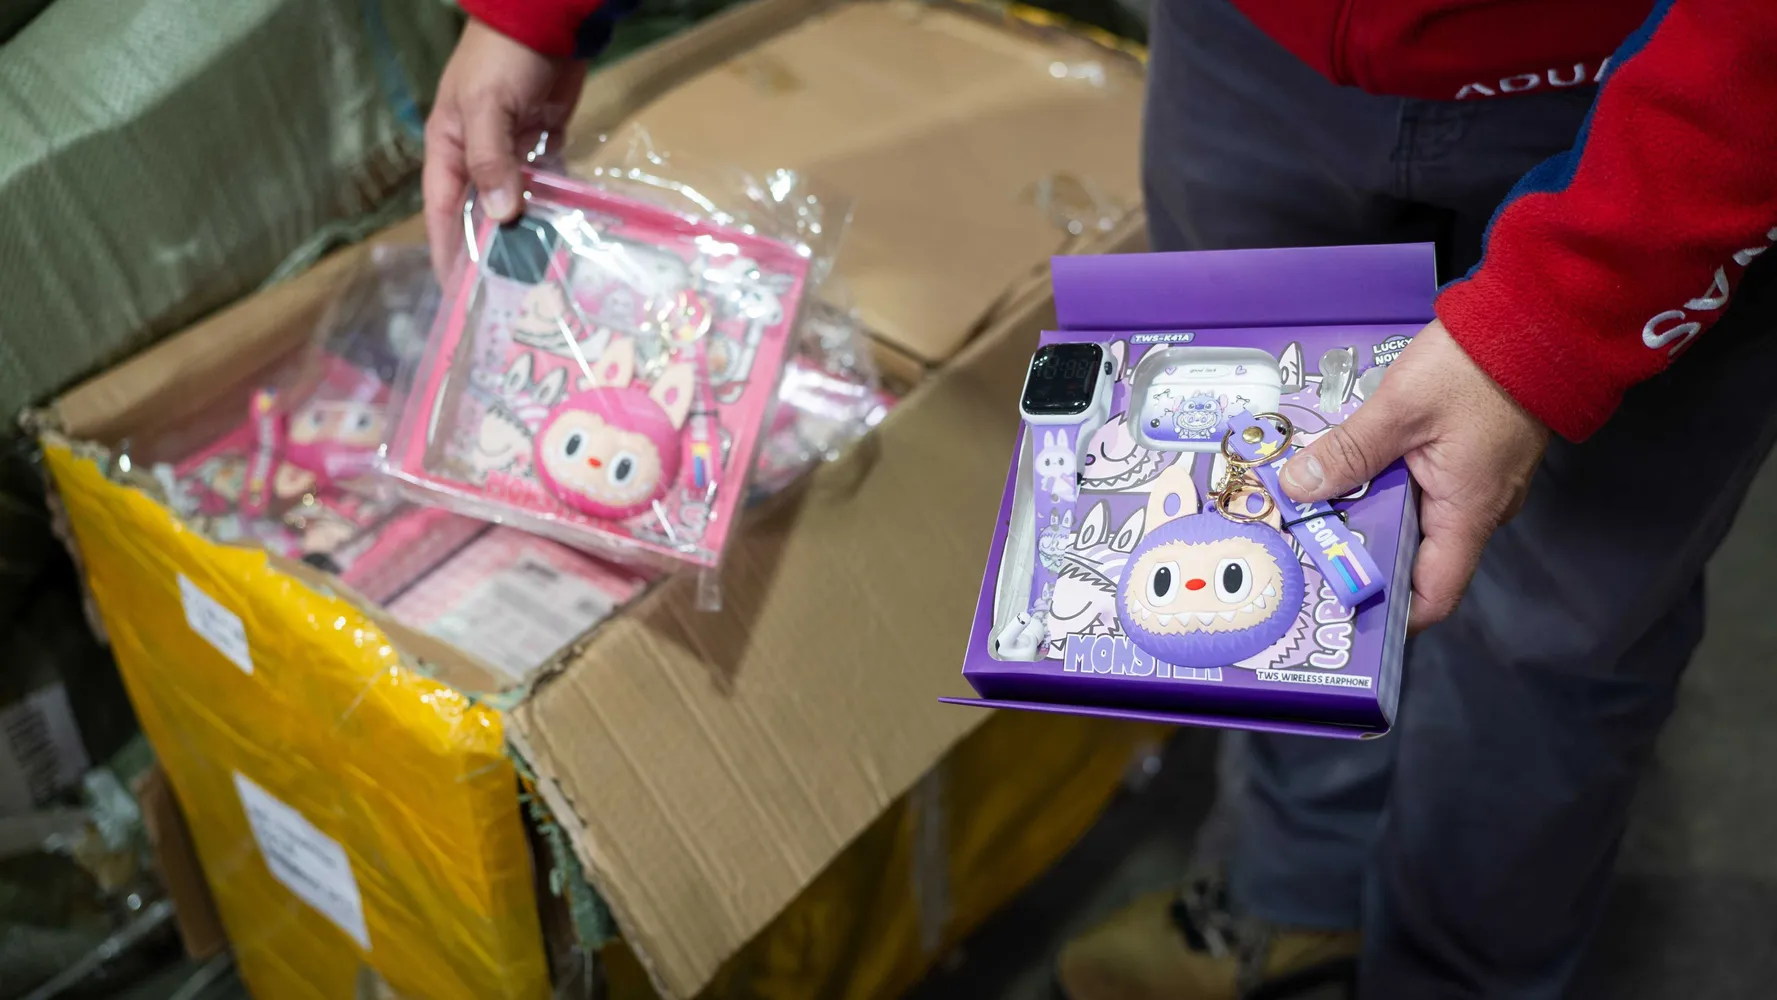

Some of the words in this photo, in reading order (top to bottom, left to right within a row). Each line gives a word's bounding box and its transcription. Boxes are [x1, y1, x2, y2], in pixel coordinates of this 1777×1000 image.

[1135, 333, 1191, 342] TWS-K41A
[1373, 337, 1413, 354] LUCKY
[1064, 633, 1223, 682] MONS
[1258, 671, 1279, 680] TWS
[1281, 673, 1323, 684] WIRELESS
[1325, 676, 1370, 687] EARPHONE
